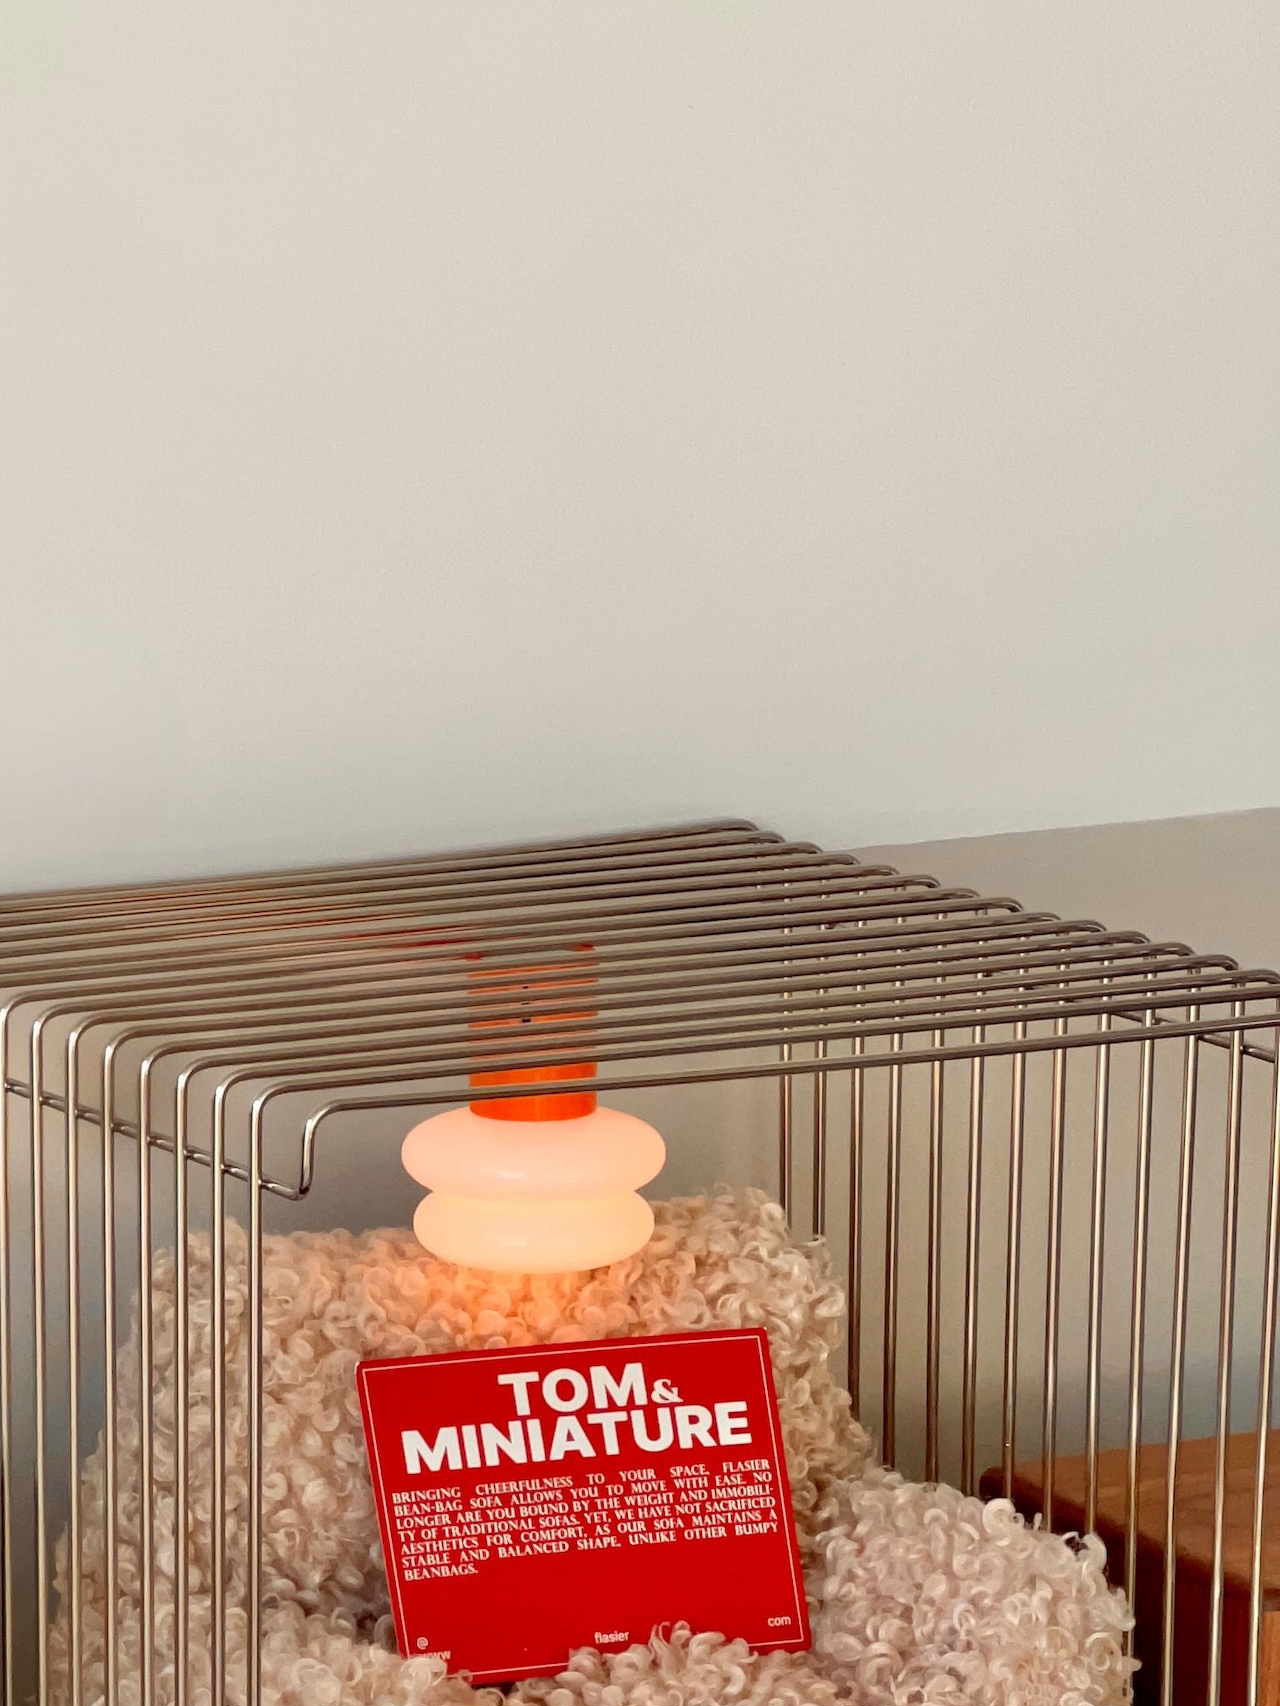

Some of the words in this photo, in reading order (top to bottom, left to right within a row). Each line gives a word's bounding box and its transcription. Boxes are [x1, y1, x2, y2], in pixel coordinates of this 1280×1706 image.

[401, 1401, 752, 1474] MINIATURE
[392, 1487, 461, 1504] BRINGING
[476, 1476, 573, 1496] CHEERFULNESS
[587, 1473, 604, 1485] TO
[620, 1468, 656, 1482] YOUR
[723, 1458, 770, 1473] FLASIER
[394, 1500, 462, 1516] BEAN-BAG
[470, 1496, 502, 1509] SOFA
[511, 1490, 562, 1505] ALLOWS
[571, 1486, 598, 1500] YOU
[606, 1484, 624, 1496] TO
[631, 1480, 666, 1494] MOVE
[674, 1477, 708, 1490] WITH
[753, 1471, 772, 1483] NO
[396, 1514, 451, 1530] LONGER
[456, 1509, 481, 1524] ARE
[486, 1506, 515, 1520] YOU
[520, 1502, 568, 1517] BOUND
[573, 1500, 589, 1512] BY
[595, 1497, 620, 1510] THE
[624, 1492, 674, 1507] WEIGHT
[680, 1490, 708, 1502] AND
[712, 1484, 774, 1500] IMMOBILI-
[398, 1530, 416, 1542] TY
[421, 1528, 438, 1540] OF
[442, 1518, 535, 1538] TRADITIONAL
[614, 1508, 634, 1520] WE
[638, 1505, 672, 1518] HAVE
[675, 1502, 702, 1516] NOT
[706, 1496, 776, 1512] SACRIFICED
[402, 1537, 478, 1555] AESTHETICS
[486, 1534, 512, 1546] FOR
[595, 1524, 610, 1536] AS
[617, 1520, 646, 1534] OUR
[654, 1517, 684, 1530] SOFA
[692, 1511, 762, 1527] MAINTAINS
[402, 1553, 450, 1568] STABLE
[460, 1549, 489, 1562] AND
[498, 1541, 569, 1558] BALANCED
[629, 1531, 676, 1545] UNLIKE
[684, 1526, 727, 1540] OTHER
[735, 1522, 778, 1536] BUMPY
[594, 1630, 630, 1645] flasier
[767, 1614, 792, 1627] com
